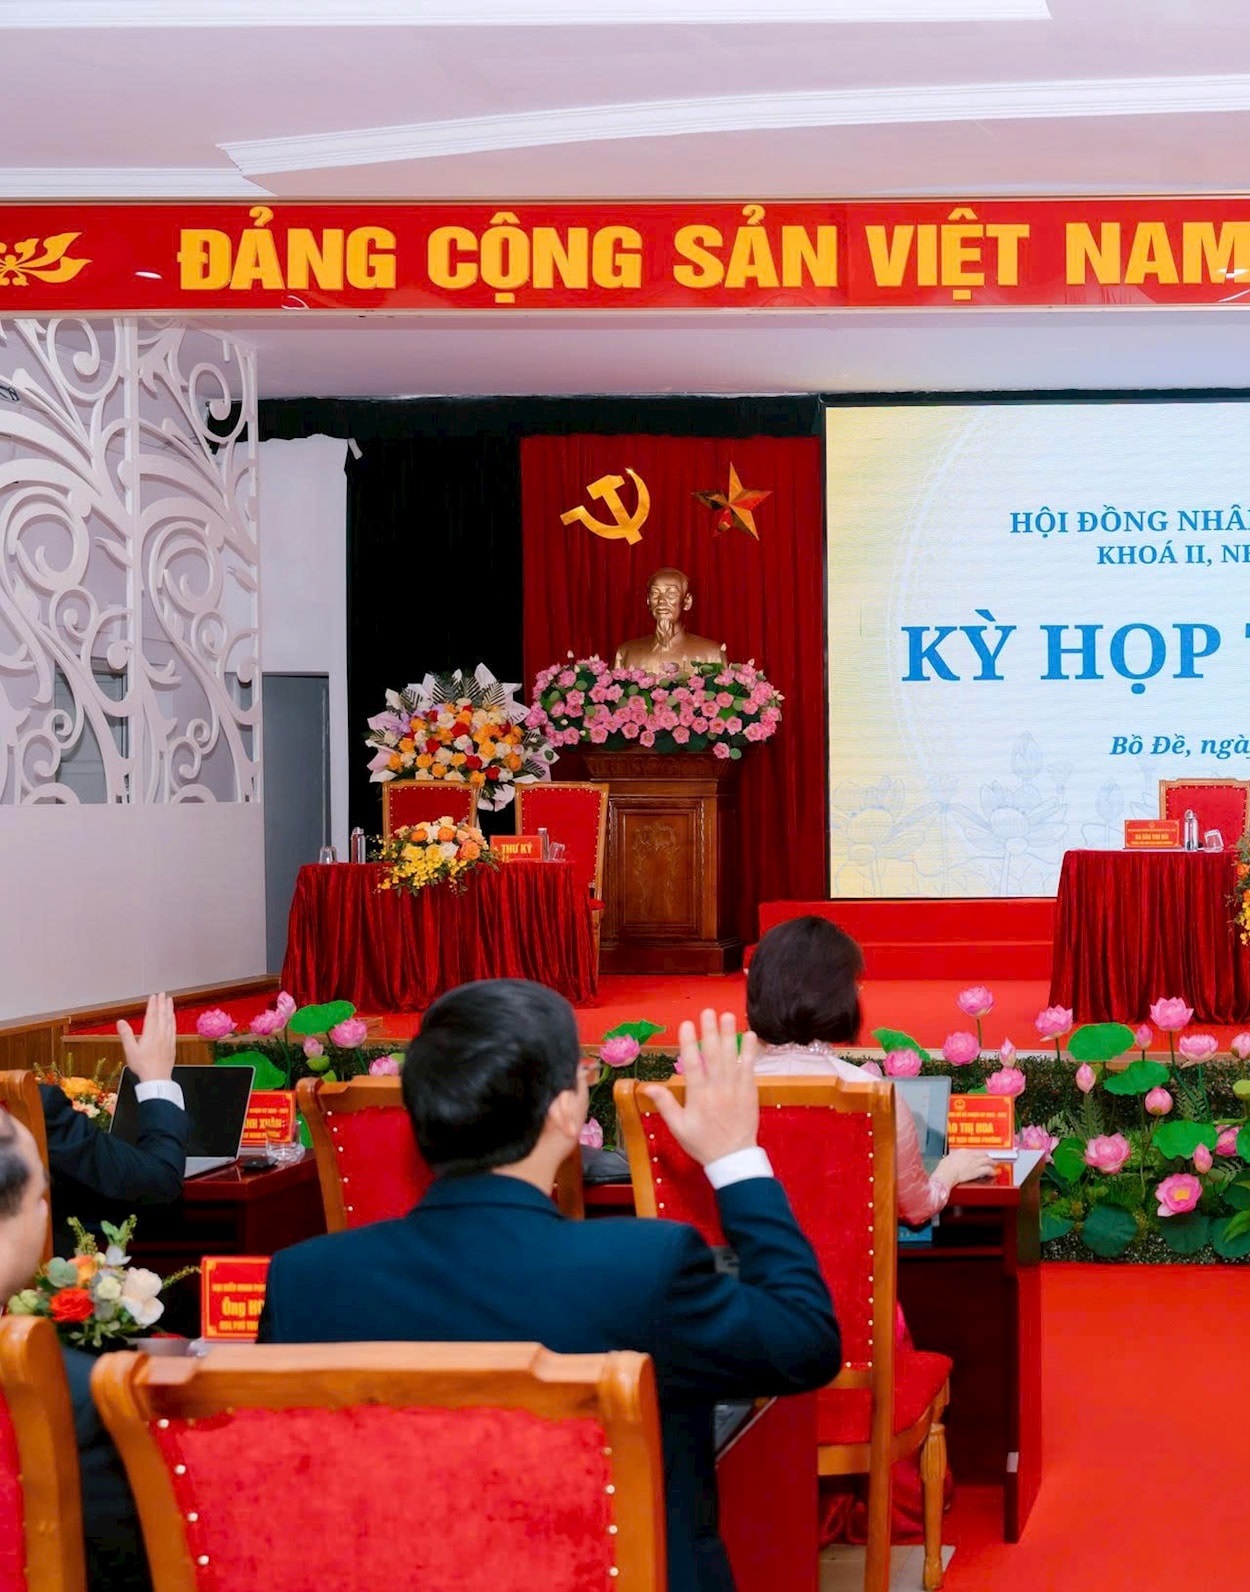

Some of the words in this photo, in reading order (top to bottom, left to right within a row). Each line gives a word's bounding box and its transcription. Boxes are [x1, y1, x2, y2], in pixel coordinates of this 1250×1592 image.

[177, 205, 396, 290] ĐẢNG
[427, 211, 642, 303] CỘNG
[673, 205, 838, 288] SẢN
[865, 207, 1030, 300] VIỆT
[1010, 506, 1068, 540] HỘI
[1077, 504, 1169, 532] ĐỒNG
[1096, 539, 1177, 566] KHOÁ
[1185, 543, 1213, 567] II,
[900, 608, 1018, 683] KỲ
[1038, 621, 1223, 696] HỌP
[1110, 733, 1145, 756] Bồ
[1151, 733, 1193, 758] Đề,
[501, 842, 520, 855] THƯ
[222, 1296, 247, 1319] Ông
